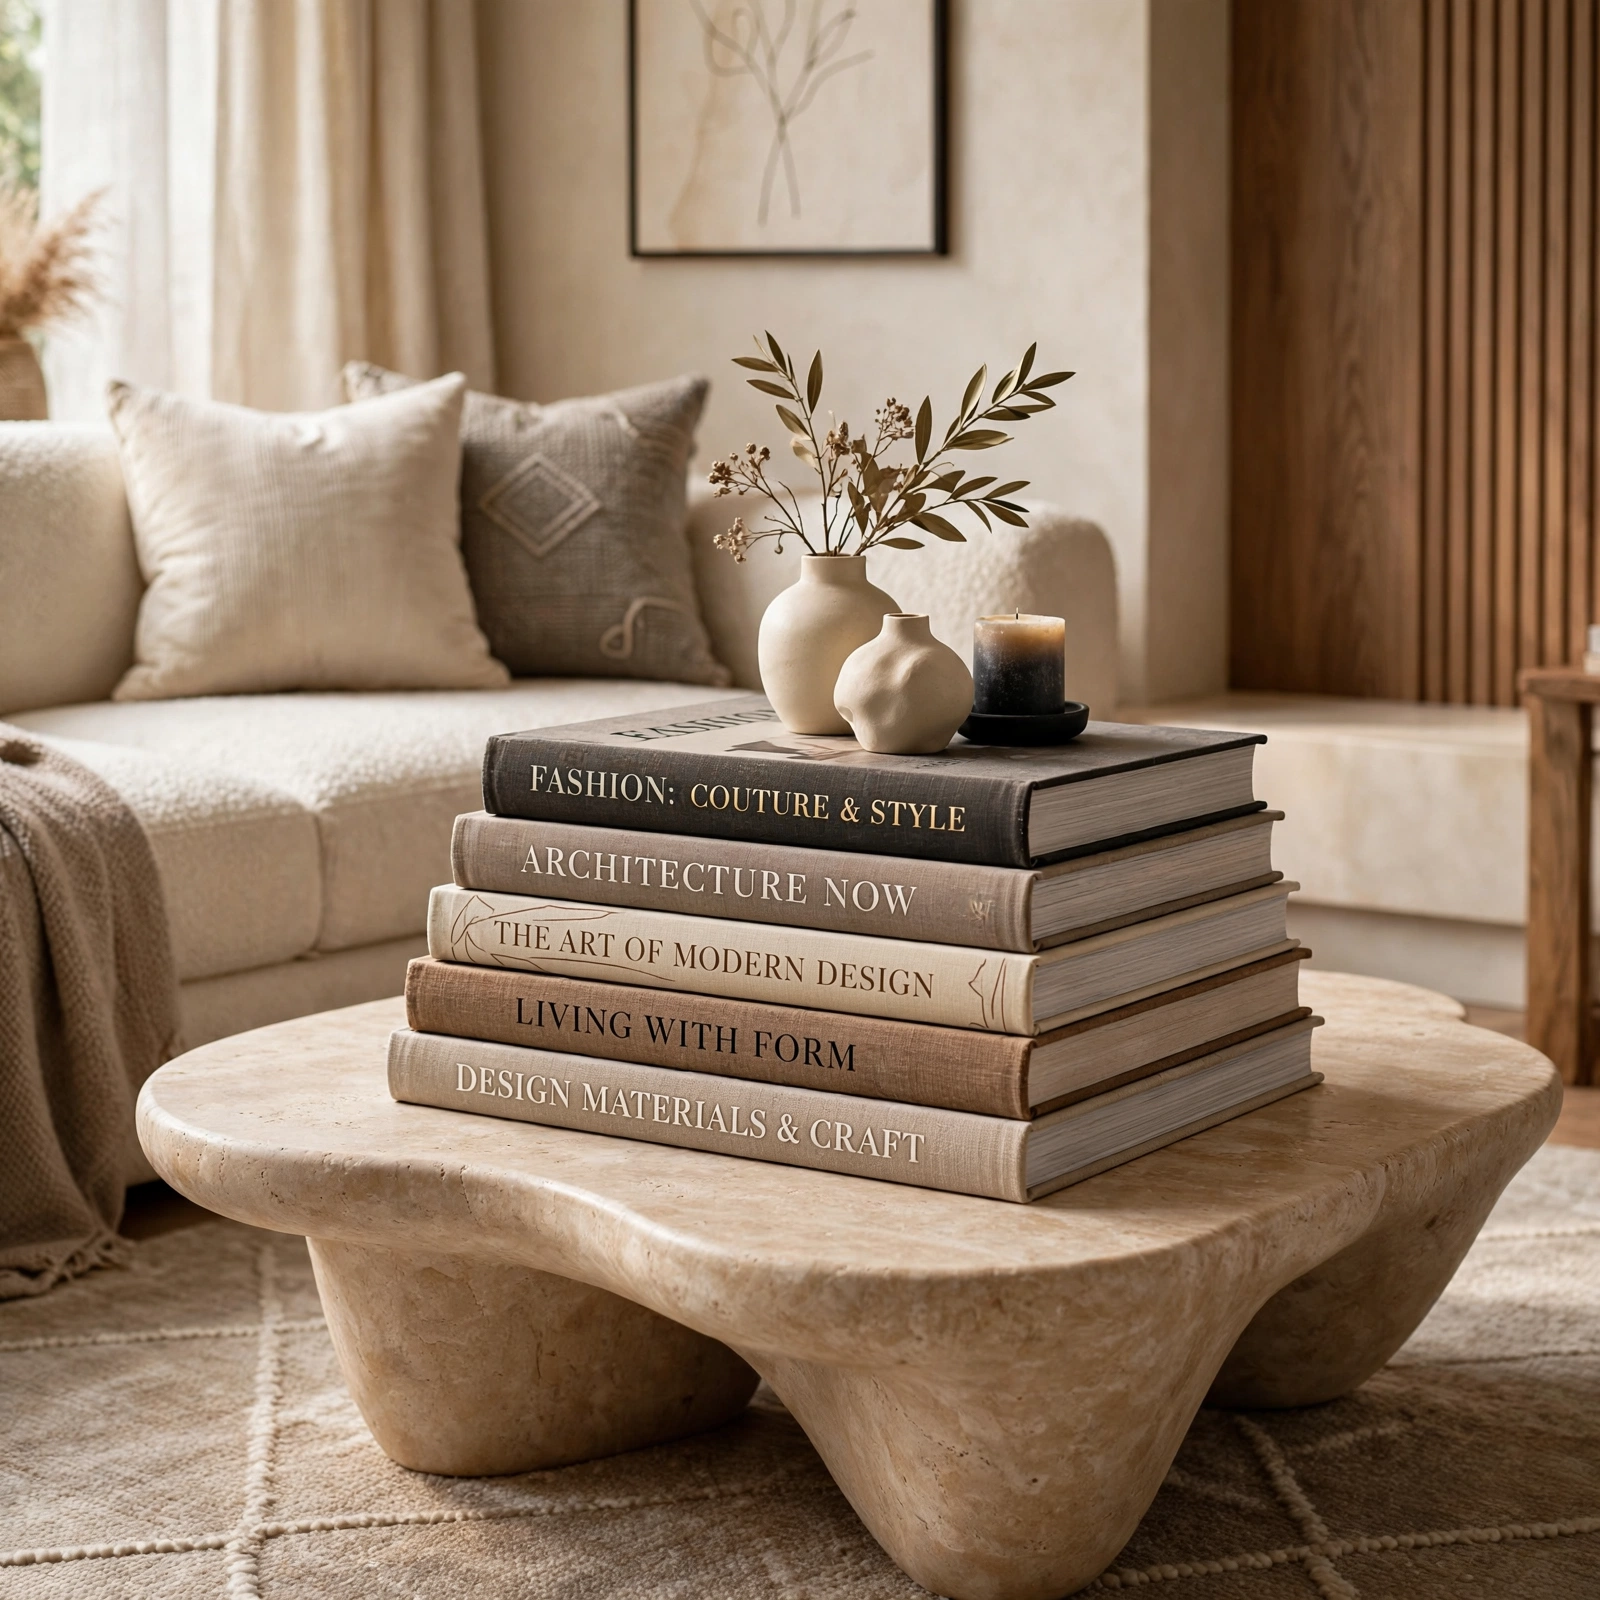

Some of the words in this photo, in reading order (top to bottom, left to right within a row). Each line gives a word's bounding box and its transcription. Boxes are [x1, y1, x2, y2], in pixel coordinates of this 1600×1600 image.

[530, 764, 674, 805] FASHION:
[690, 783, 829, 820] COUTURE
[840, 796, 861, 823] &
[870, 798, 966, 832] STYLE
[520, 844, 807, 904] ARCHITECTURE
[823, 876, 917, 916] NOW
[493, 920, 551, 951] THE
[558, 929, 616, 958] ART
[624, 936, 664, 964] OF
[673, 941, 805, 983] MODERN
[816, 959, 935, 999] DESIGN
[515, 997, 632, 1039] LIVING
[644, 1014, 738, 1054] WITH
[753, 1030, 857, 1072] FORM
[455, 1062, 571, 1108] DESIGN
[581, 1082, 766, 1139] MATERIALS
[776, 1113, 800, 1145] &
[809, 1118, 925, 1163] CRAFT
